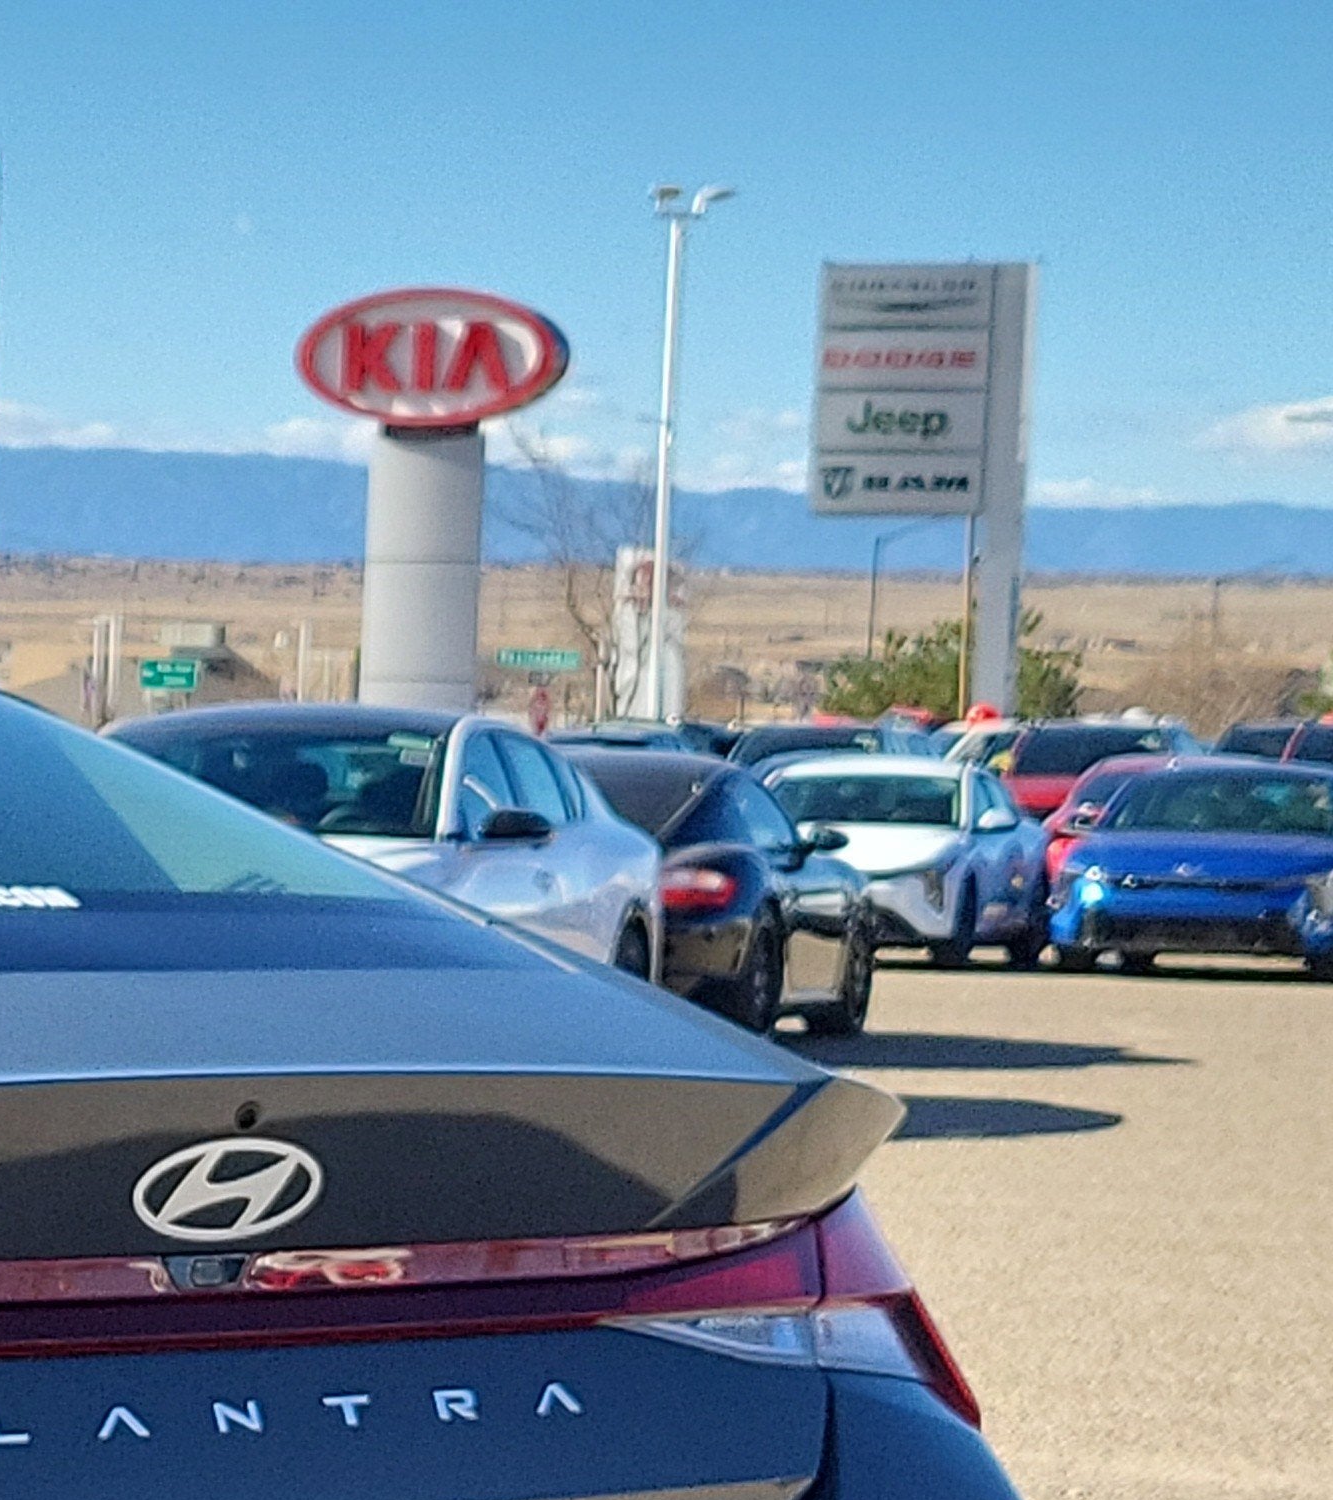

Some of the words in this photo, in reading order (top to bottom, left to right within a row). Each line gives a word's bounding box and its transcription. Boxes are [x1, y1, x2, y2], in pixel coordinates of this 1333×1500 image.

[343, 321, 510, 393] KIA
[847, 398, 950, 438] Jeep
[862, 475, 971, 493] RAM
